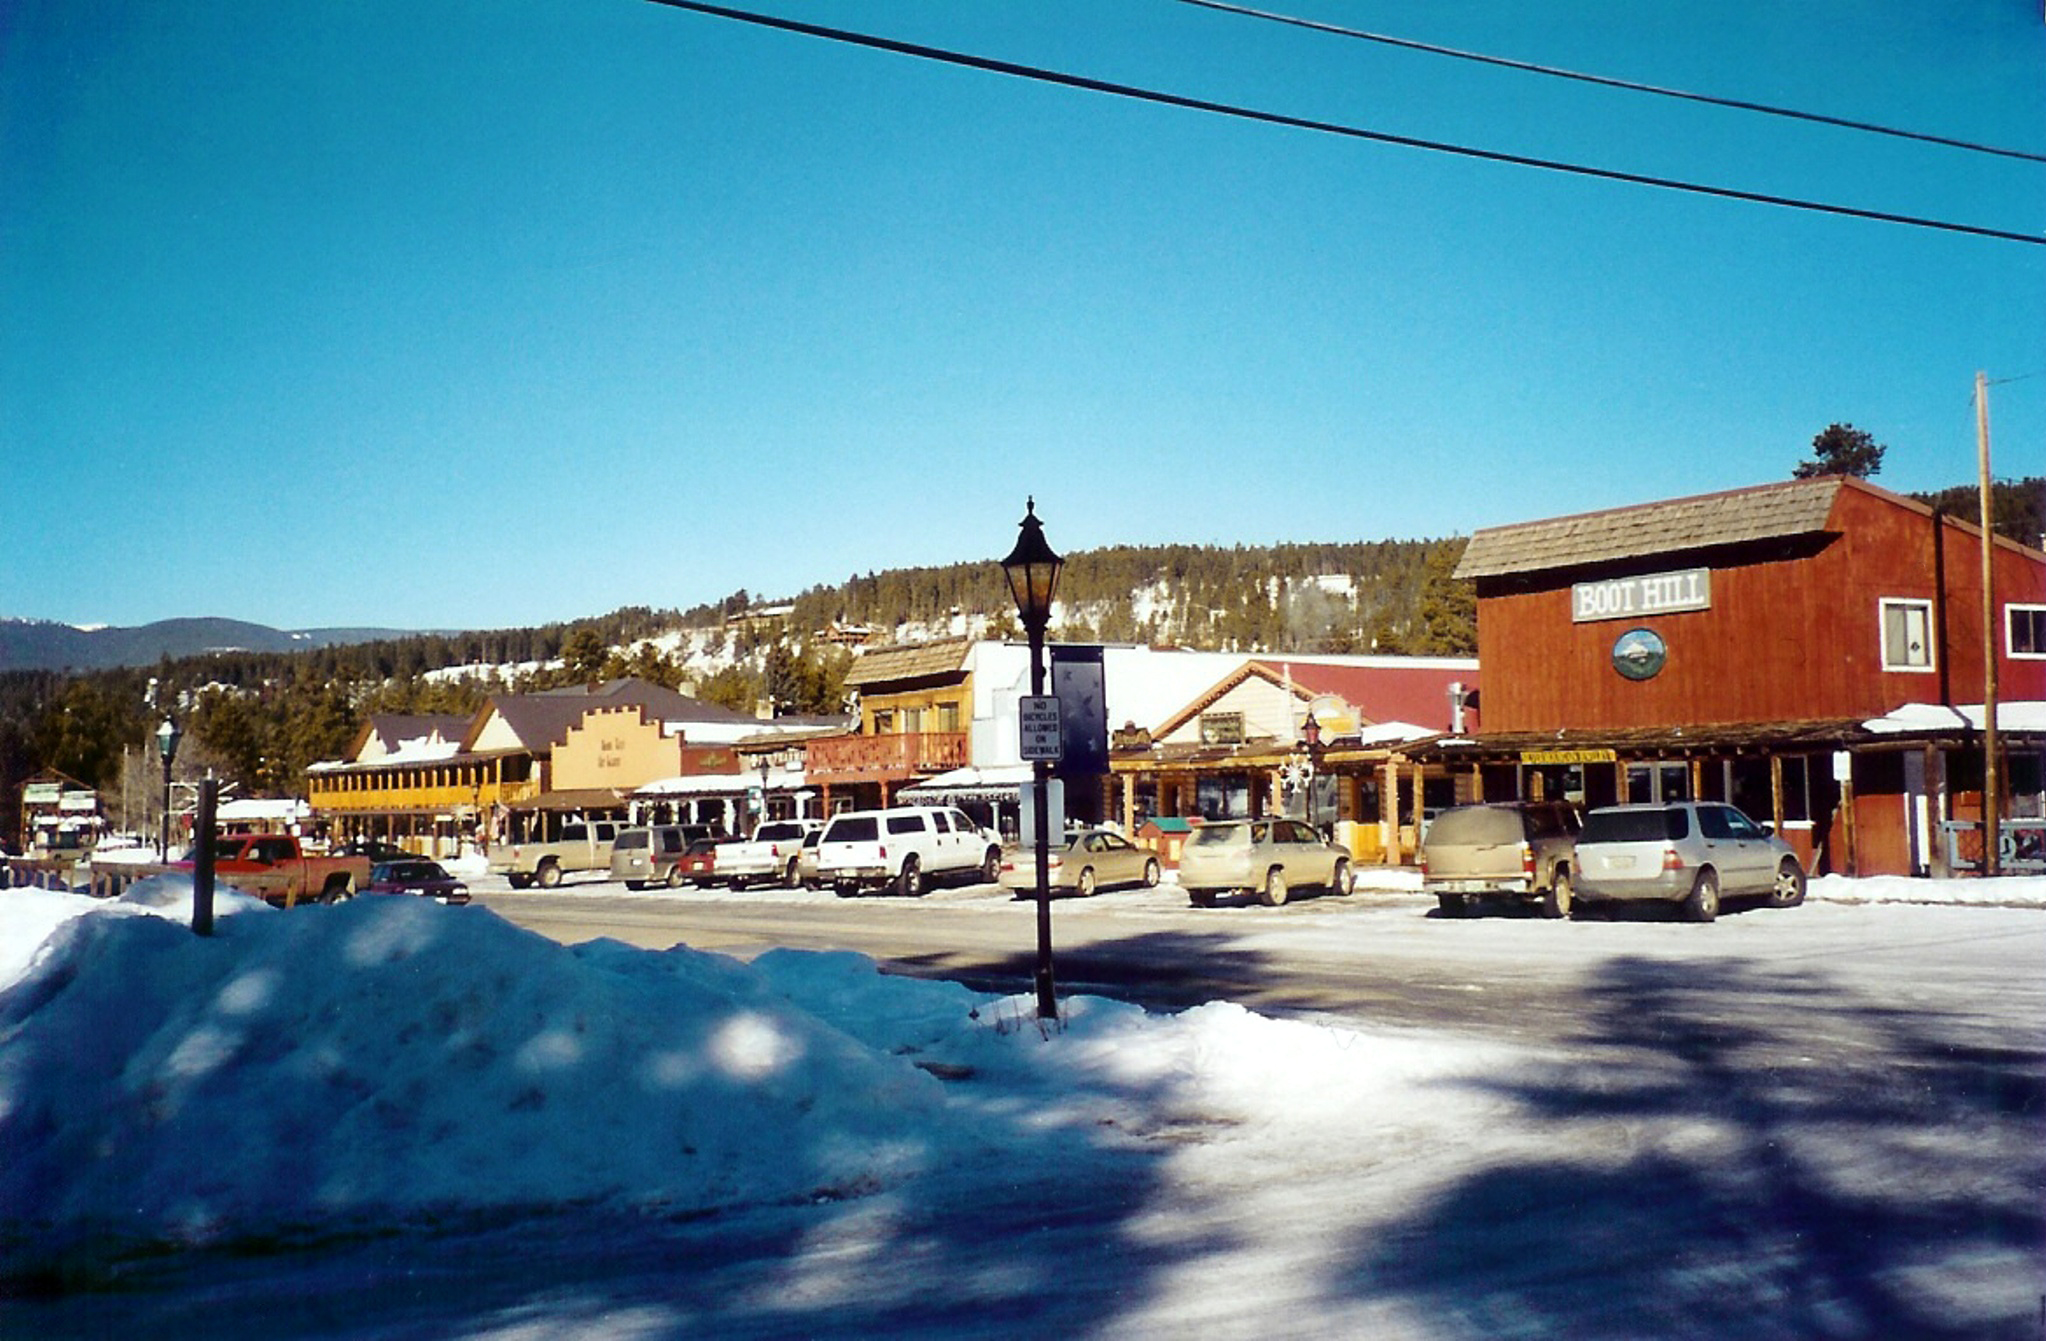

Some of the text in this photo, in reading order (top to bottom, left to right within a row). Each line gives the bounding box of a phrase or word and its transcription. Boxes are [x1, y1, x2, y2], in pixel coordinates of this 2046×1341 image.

[1577, 573, 1705, 616] BOOT HILL
[1033, 701, 1047, 710] NO
[1024, 723, 1057, 732] ALLOWED
[1035, 735, 1046, 744] ON
[1023, 746, 1059, 755] SIDEWALK
